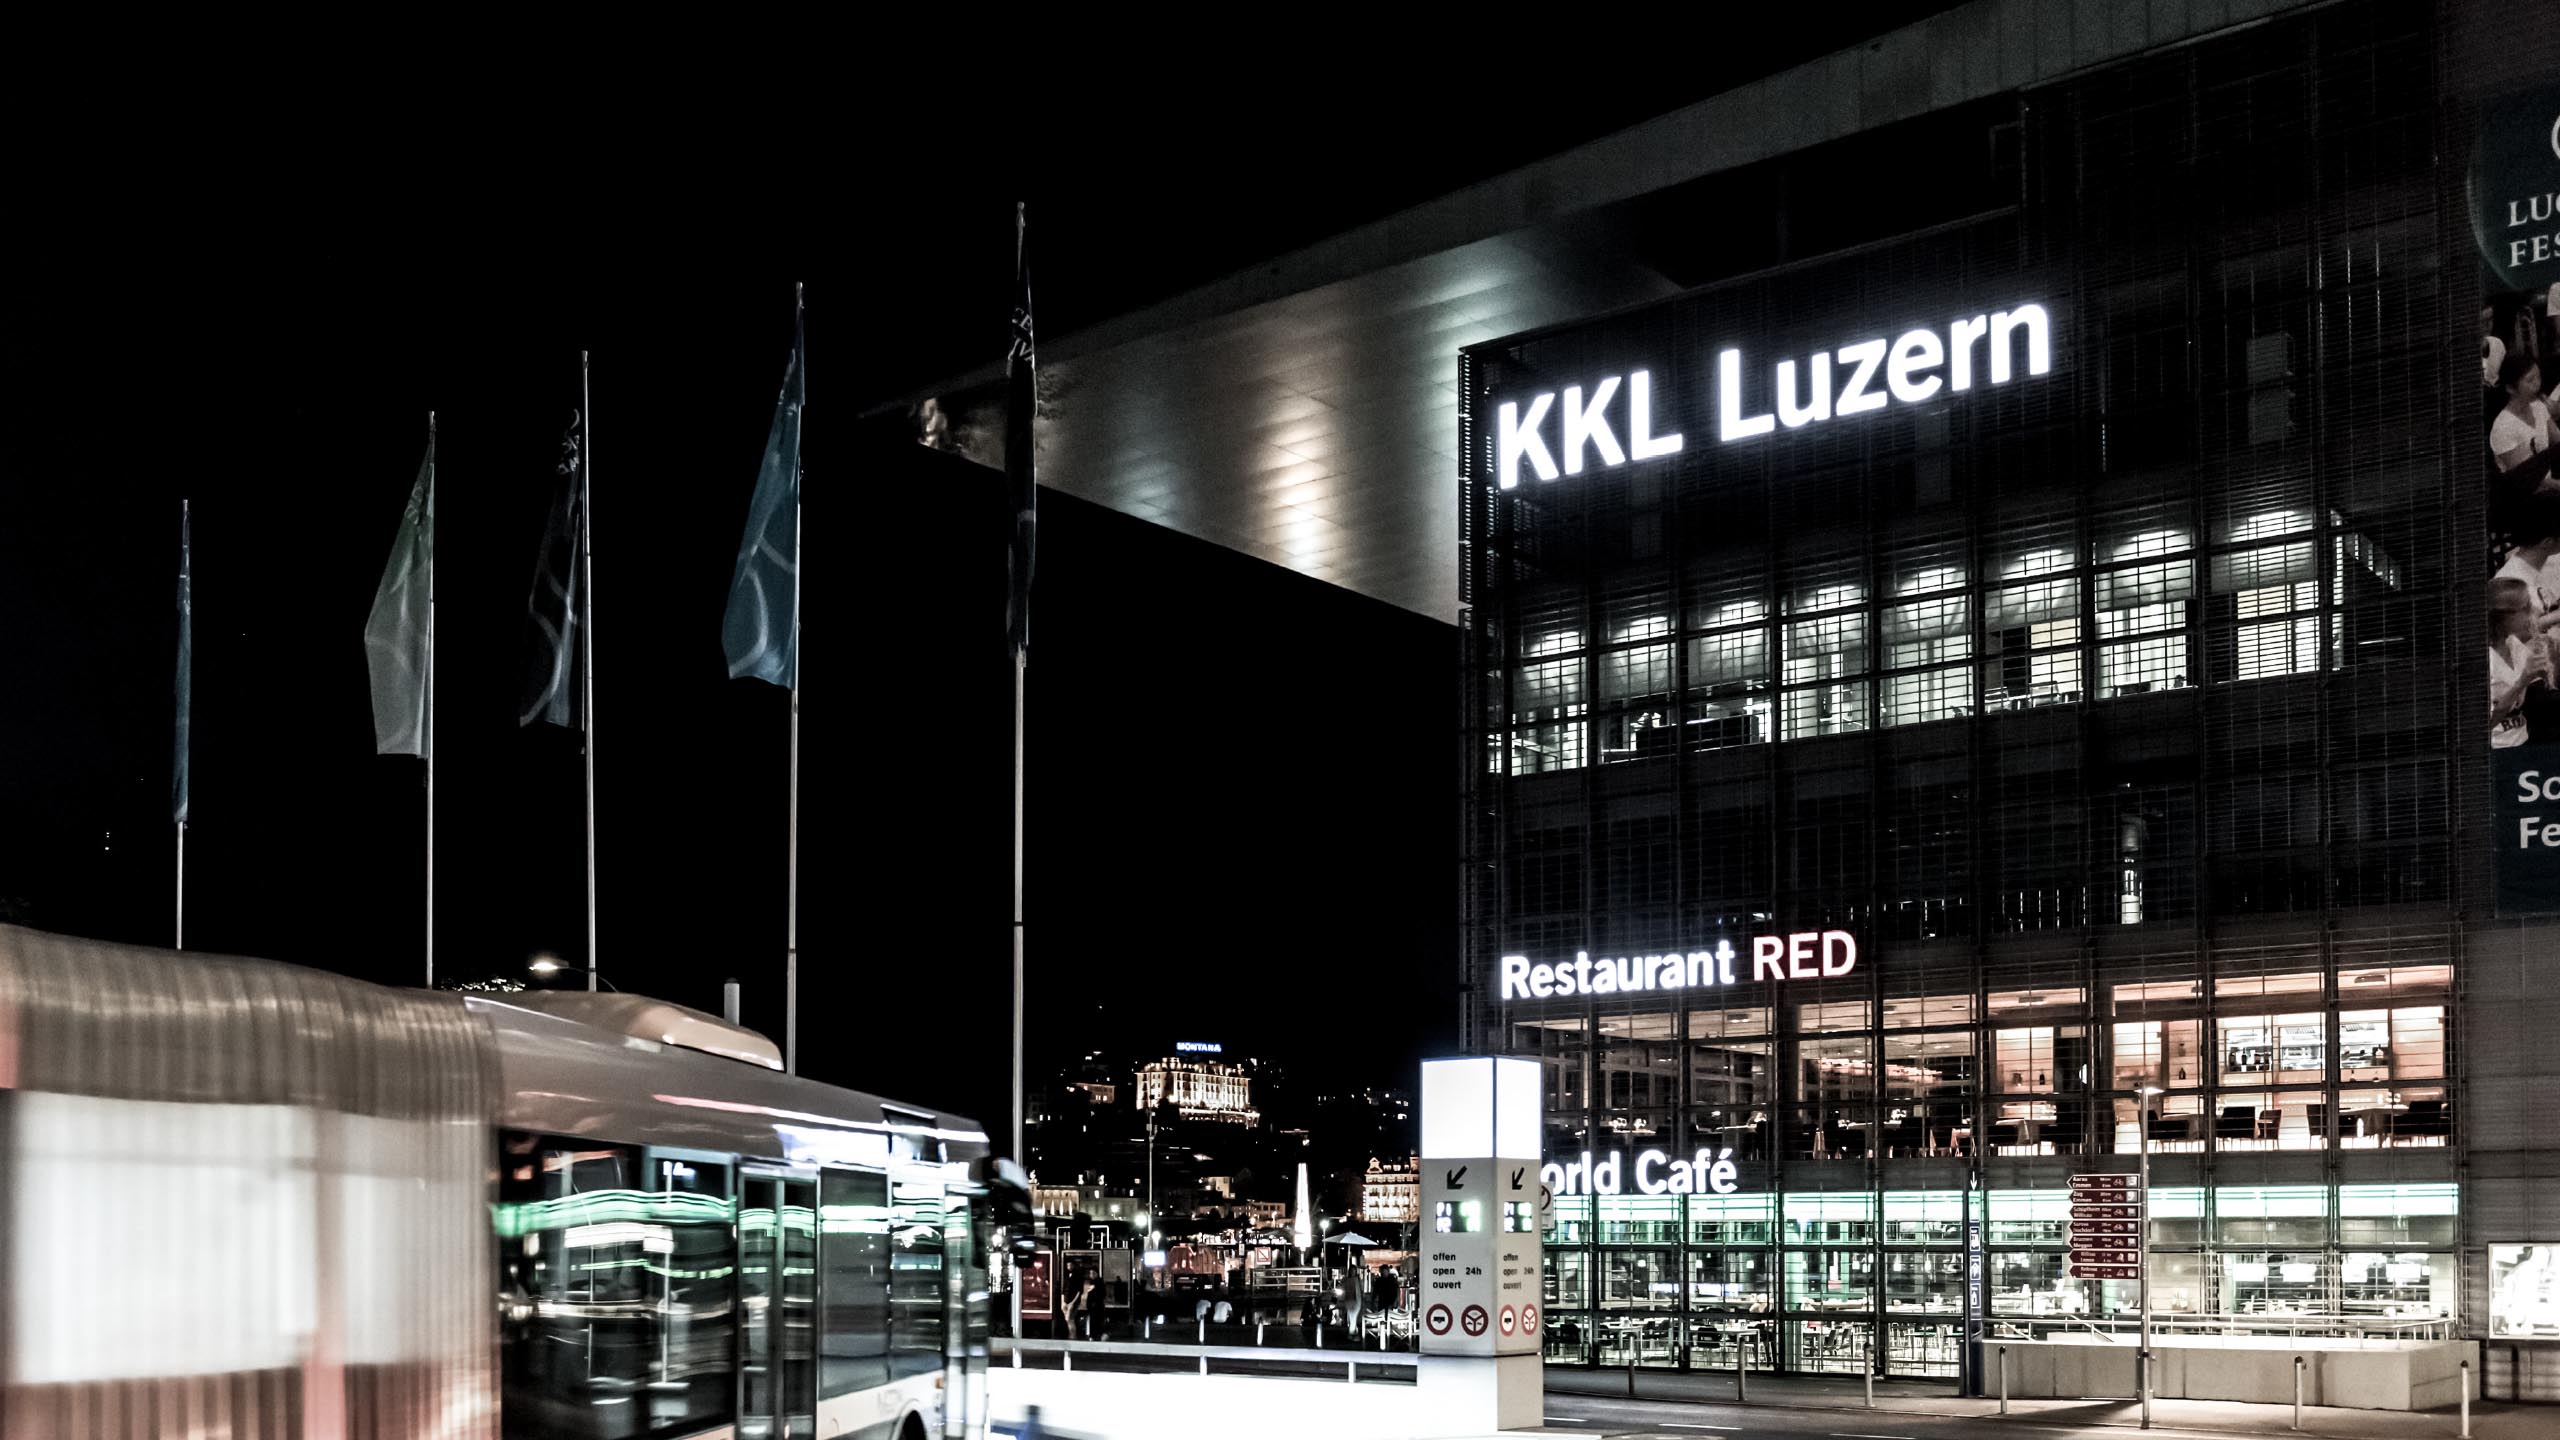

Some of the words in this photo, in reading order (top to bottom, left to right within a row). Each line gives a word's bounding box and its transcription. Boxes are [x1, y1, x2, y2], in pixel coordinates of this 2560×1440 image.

[1498, 369, 1683, 490] KKL
[1718, 302, 2051, 442] Luzern
[2519, 816, 2560, 849] Fe
[1500, 939, 1736, 1000] Restaurant
[1753, 929, 1857, 981] RED
[1176, 1041, 1222, 1053] MONTANA
[1540, 1151, 1620, 1195] orld
[1635, 1148, 1738, 1195] Café
[1432, 1252, 1456, 1261] offen
[1432, 1267, 1455, 1276] open
[1465, 1266, 1482, 1276] 24h
[1432, 1280, 1462, 1290] ouvert
